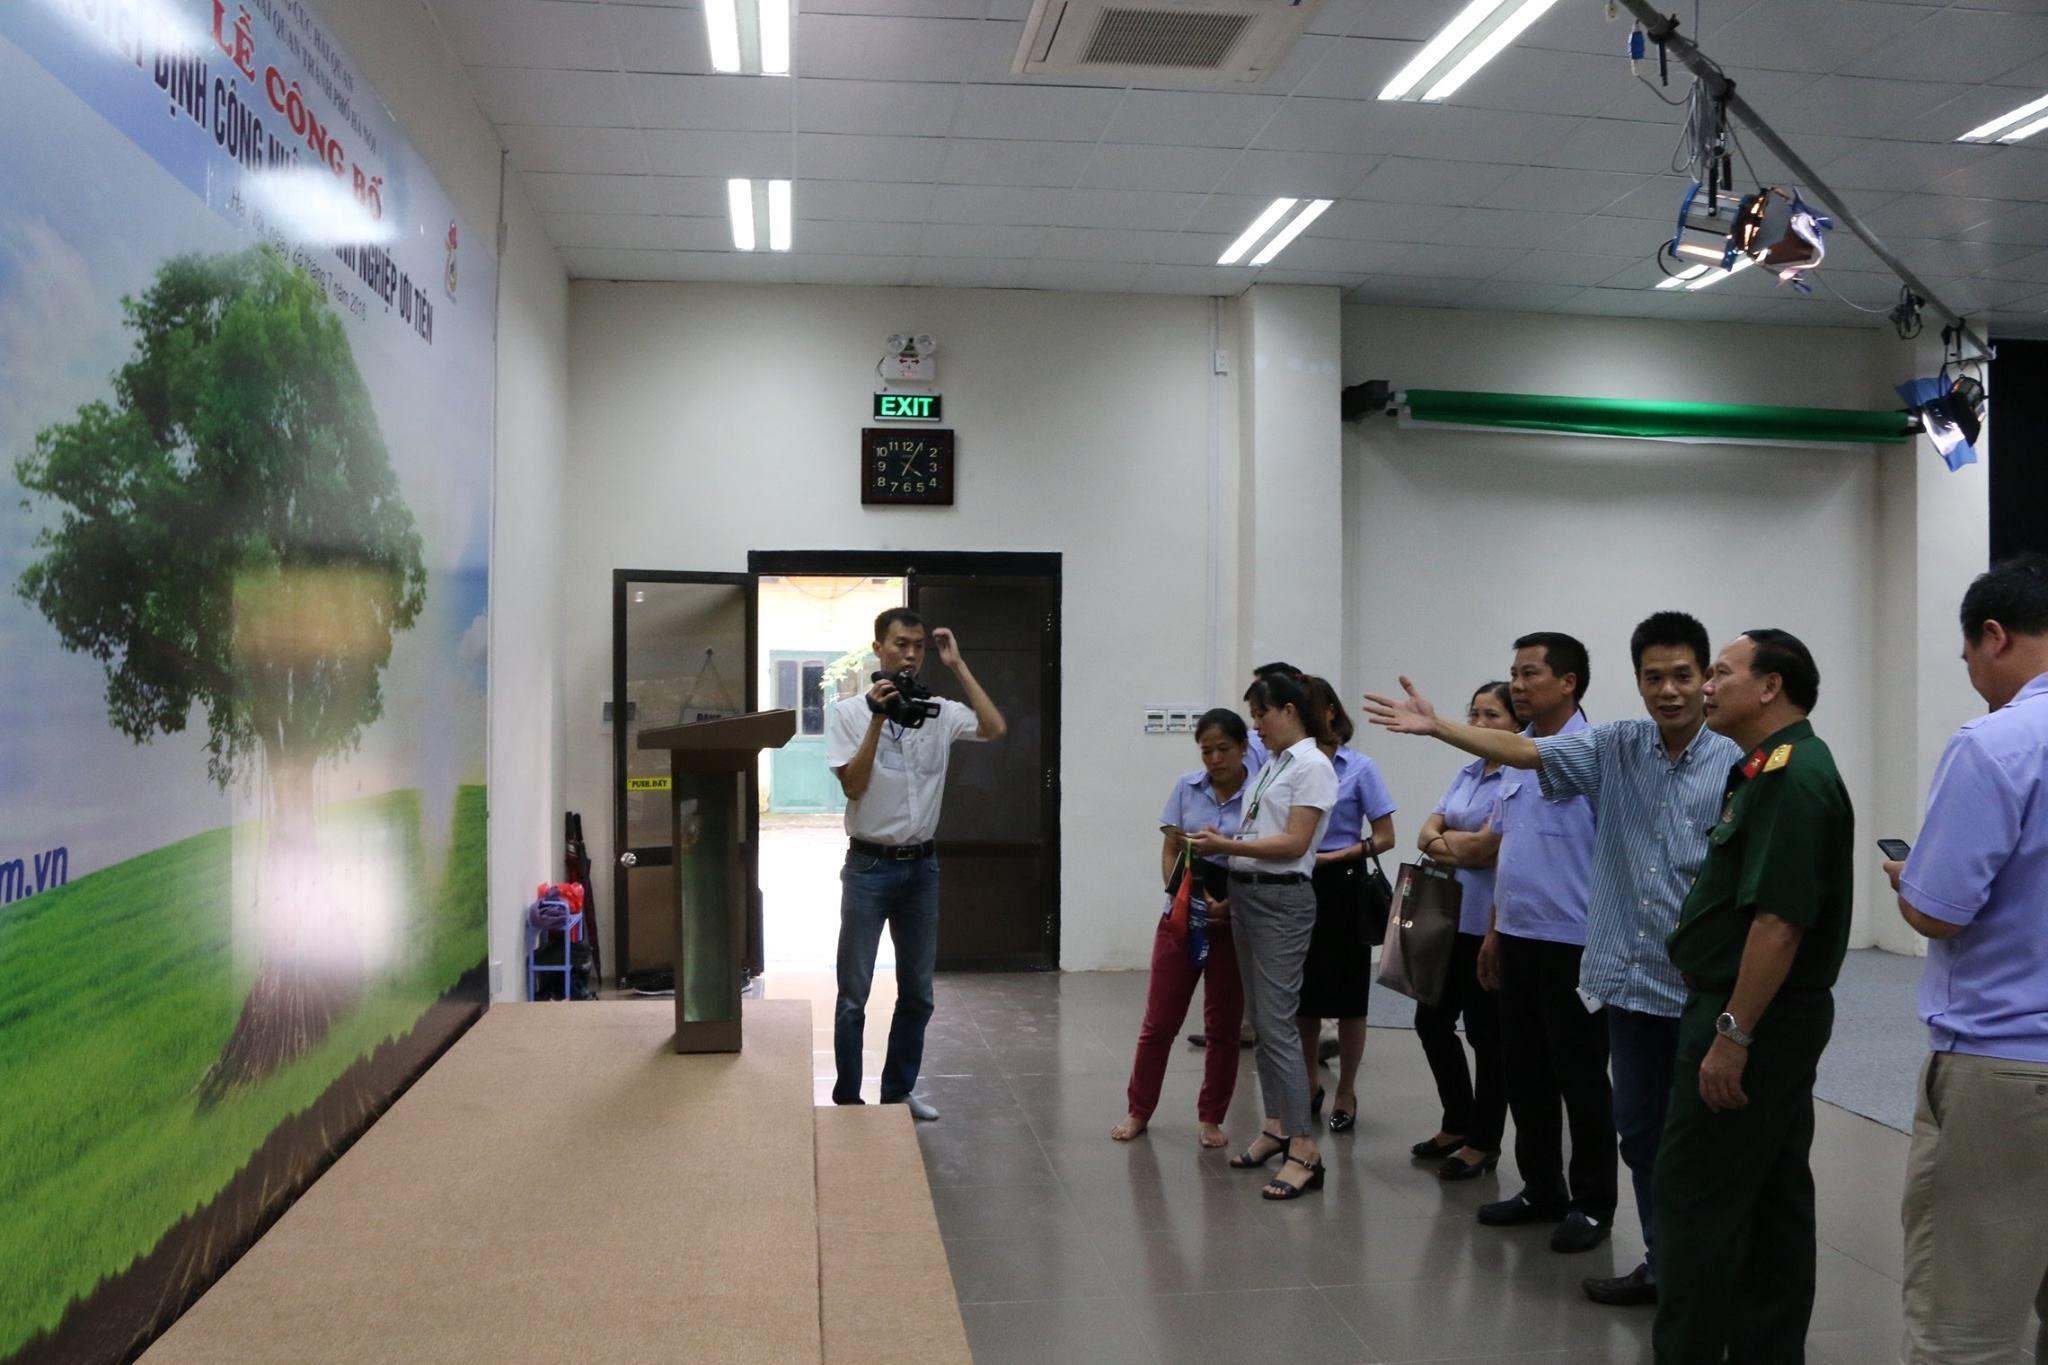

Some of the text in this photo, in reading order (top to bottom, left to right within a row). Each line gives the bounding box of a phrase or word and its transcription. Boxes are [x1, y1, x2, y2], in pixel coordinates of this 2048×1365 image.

[214, 76, 264, 172] CÔNG
[265, 66, 345, 177] CÔNG
[414, 287, 434, 346] TIÊN
[880, 396, 934, 417] EXIT
[876, 446, 888, 457] 10
[889, 441, 899, 451] 11
[902, 441, 914, 452] 12
[929, 447, 938, 458] 2
[878, 461, 887, 472] 9
[929, 462, 938, 473] 3
[877, 476, 886, 487] 8
[890, 481, 899, 492] 7
[929, 477, 937, 488] 4
[903, 482, 912, 493] 6
[916, 482, 925, 493] 5
